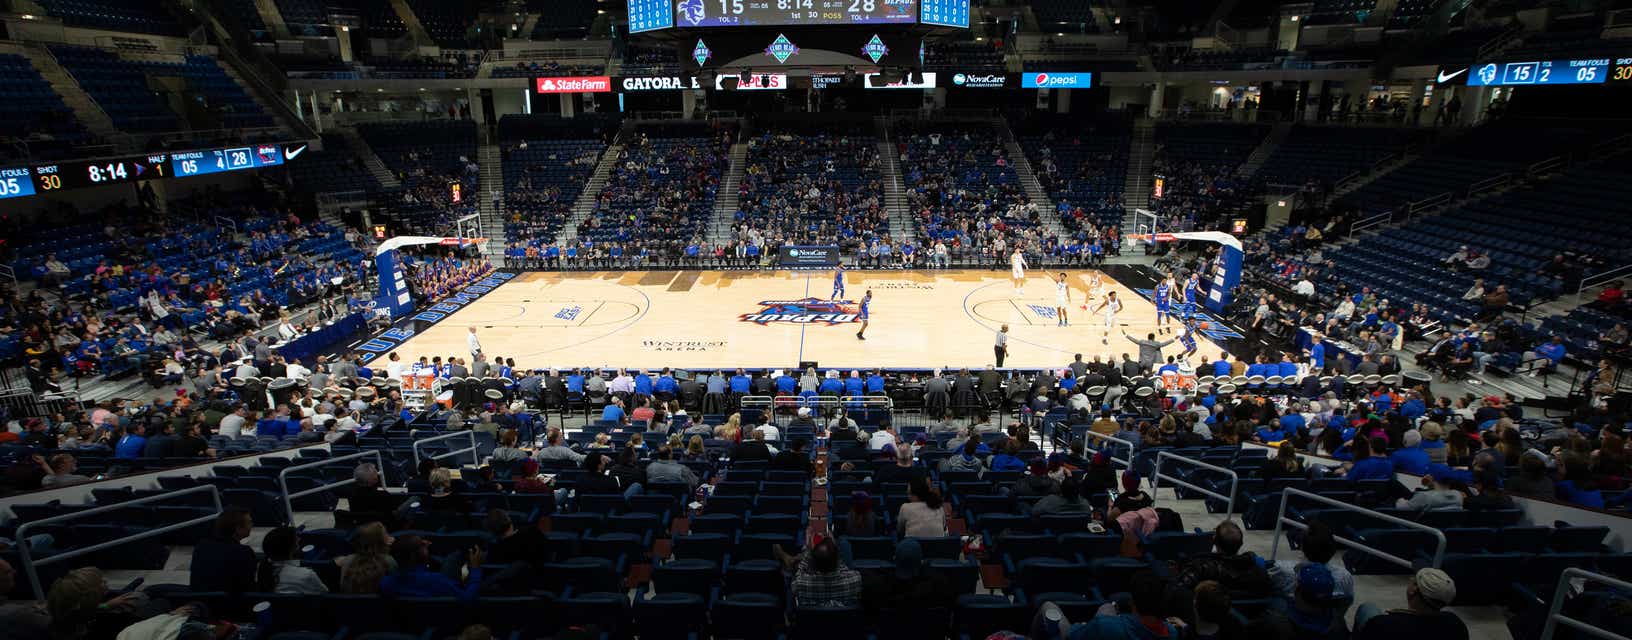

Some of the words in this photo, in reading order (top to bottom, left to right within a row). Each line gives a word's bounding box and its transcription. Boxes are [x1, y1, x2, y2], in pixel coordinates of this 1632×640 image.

[718, 0, 744, 14] 15
[777, 0, 813, 10] 8:14
[848, 0, 875, 12] 28
[966, 74, 1005, 83] NovaCare
[1513, 66, 1530, 80] 15
[1540, 69, 1551, 82] 2
[1576, 67, 1596, 81] 05
[1614, 66, 1632, 80] 30
[623, 77, 700, 90] GATORAE
[1050, 77, 1077, 86] pepsi
[148, 155, 166, 164] HALF
[2, 168, 29, 178] FOULS
[37, 165, 58, 174] SHOT
[88, 162, 127, 182] 8:14
[156, 164, 163, 176] 1
[182, 160, 198, 174] 05
[217, 157, 224, 169] 4
[232, 151, 247, 166] 28
[0, 178, 20, 195] 05
[41, 174, 61, 190] 30
[410, 272, 515, 322] DEMONS
